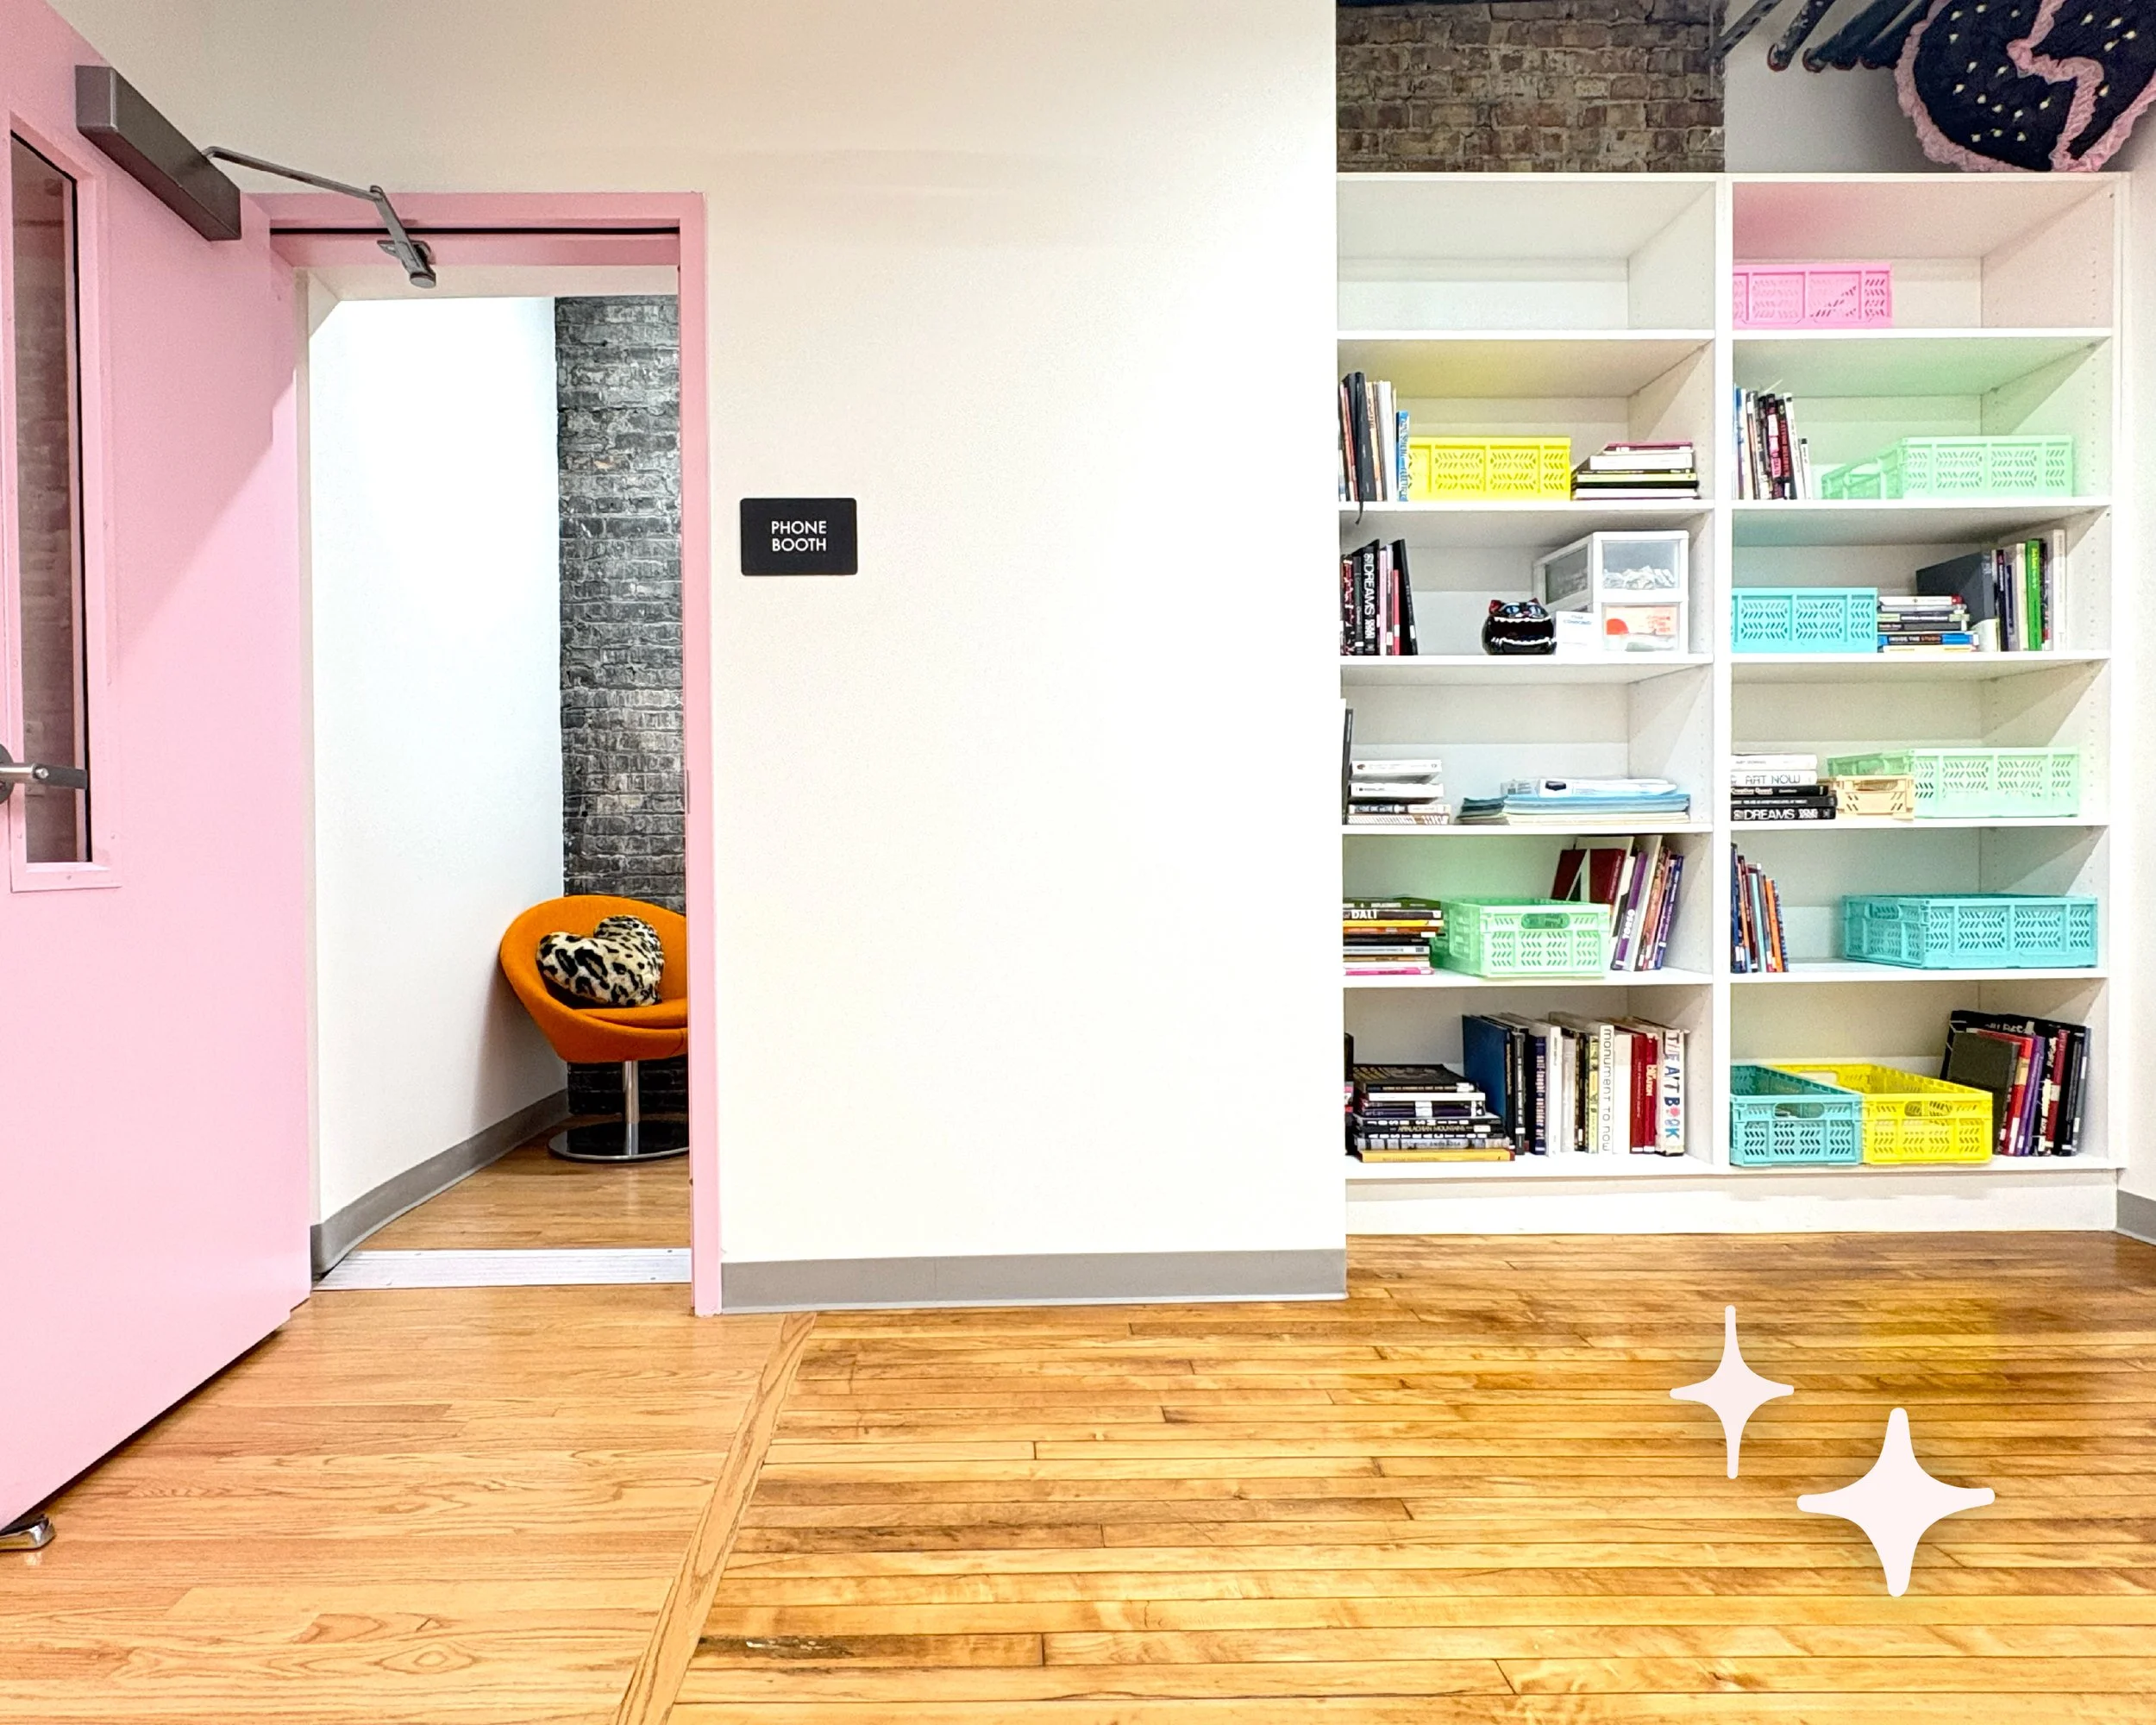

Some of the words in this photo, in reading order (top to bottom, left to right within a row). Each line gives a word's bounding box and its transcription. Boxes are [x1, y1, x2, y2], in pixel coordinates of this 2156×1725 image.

[771, 520, 827, 535] PHONE
[772, 538, 827, 552] BOOTH
[1363, 563, 1376, 616] DREAMS
[1745, 775, 1767, 785] ART
[1771, 774, 1801, 785] NOW
[1744, 808, 1796, 820] DREAMS
[1621, 908, 1636, 939] TORSO
[1536, 1055, 1545, 1093] self-taught
[1536, 1097, 1545, 1126] outsider
[1536, 1128, 1545, 1140] art
